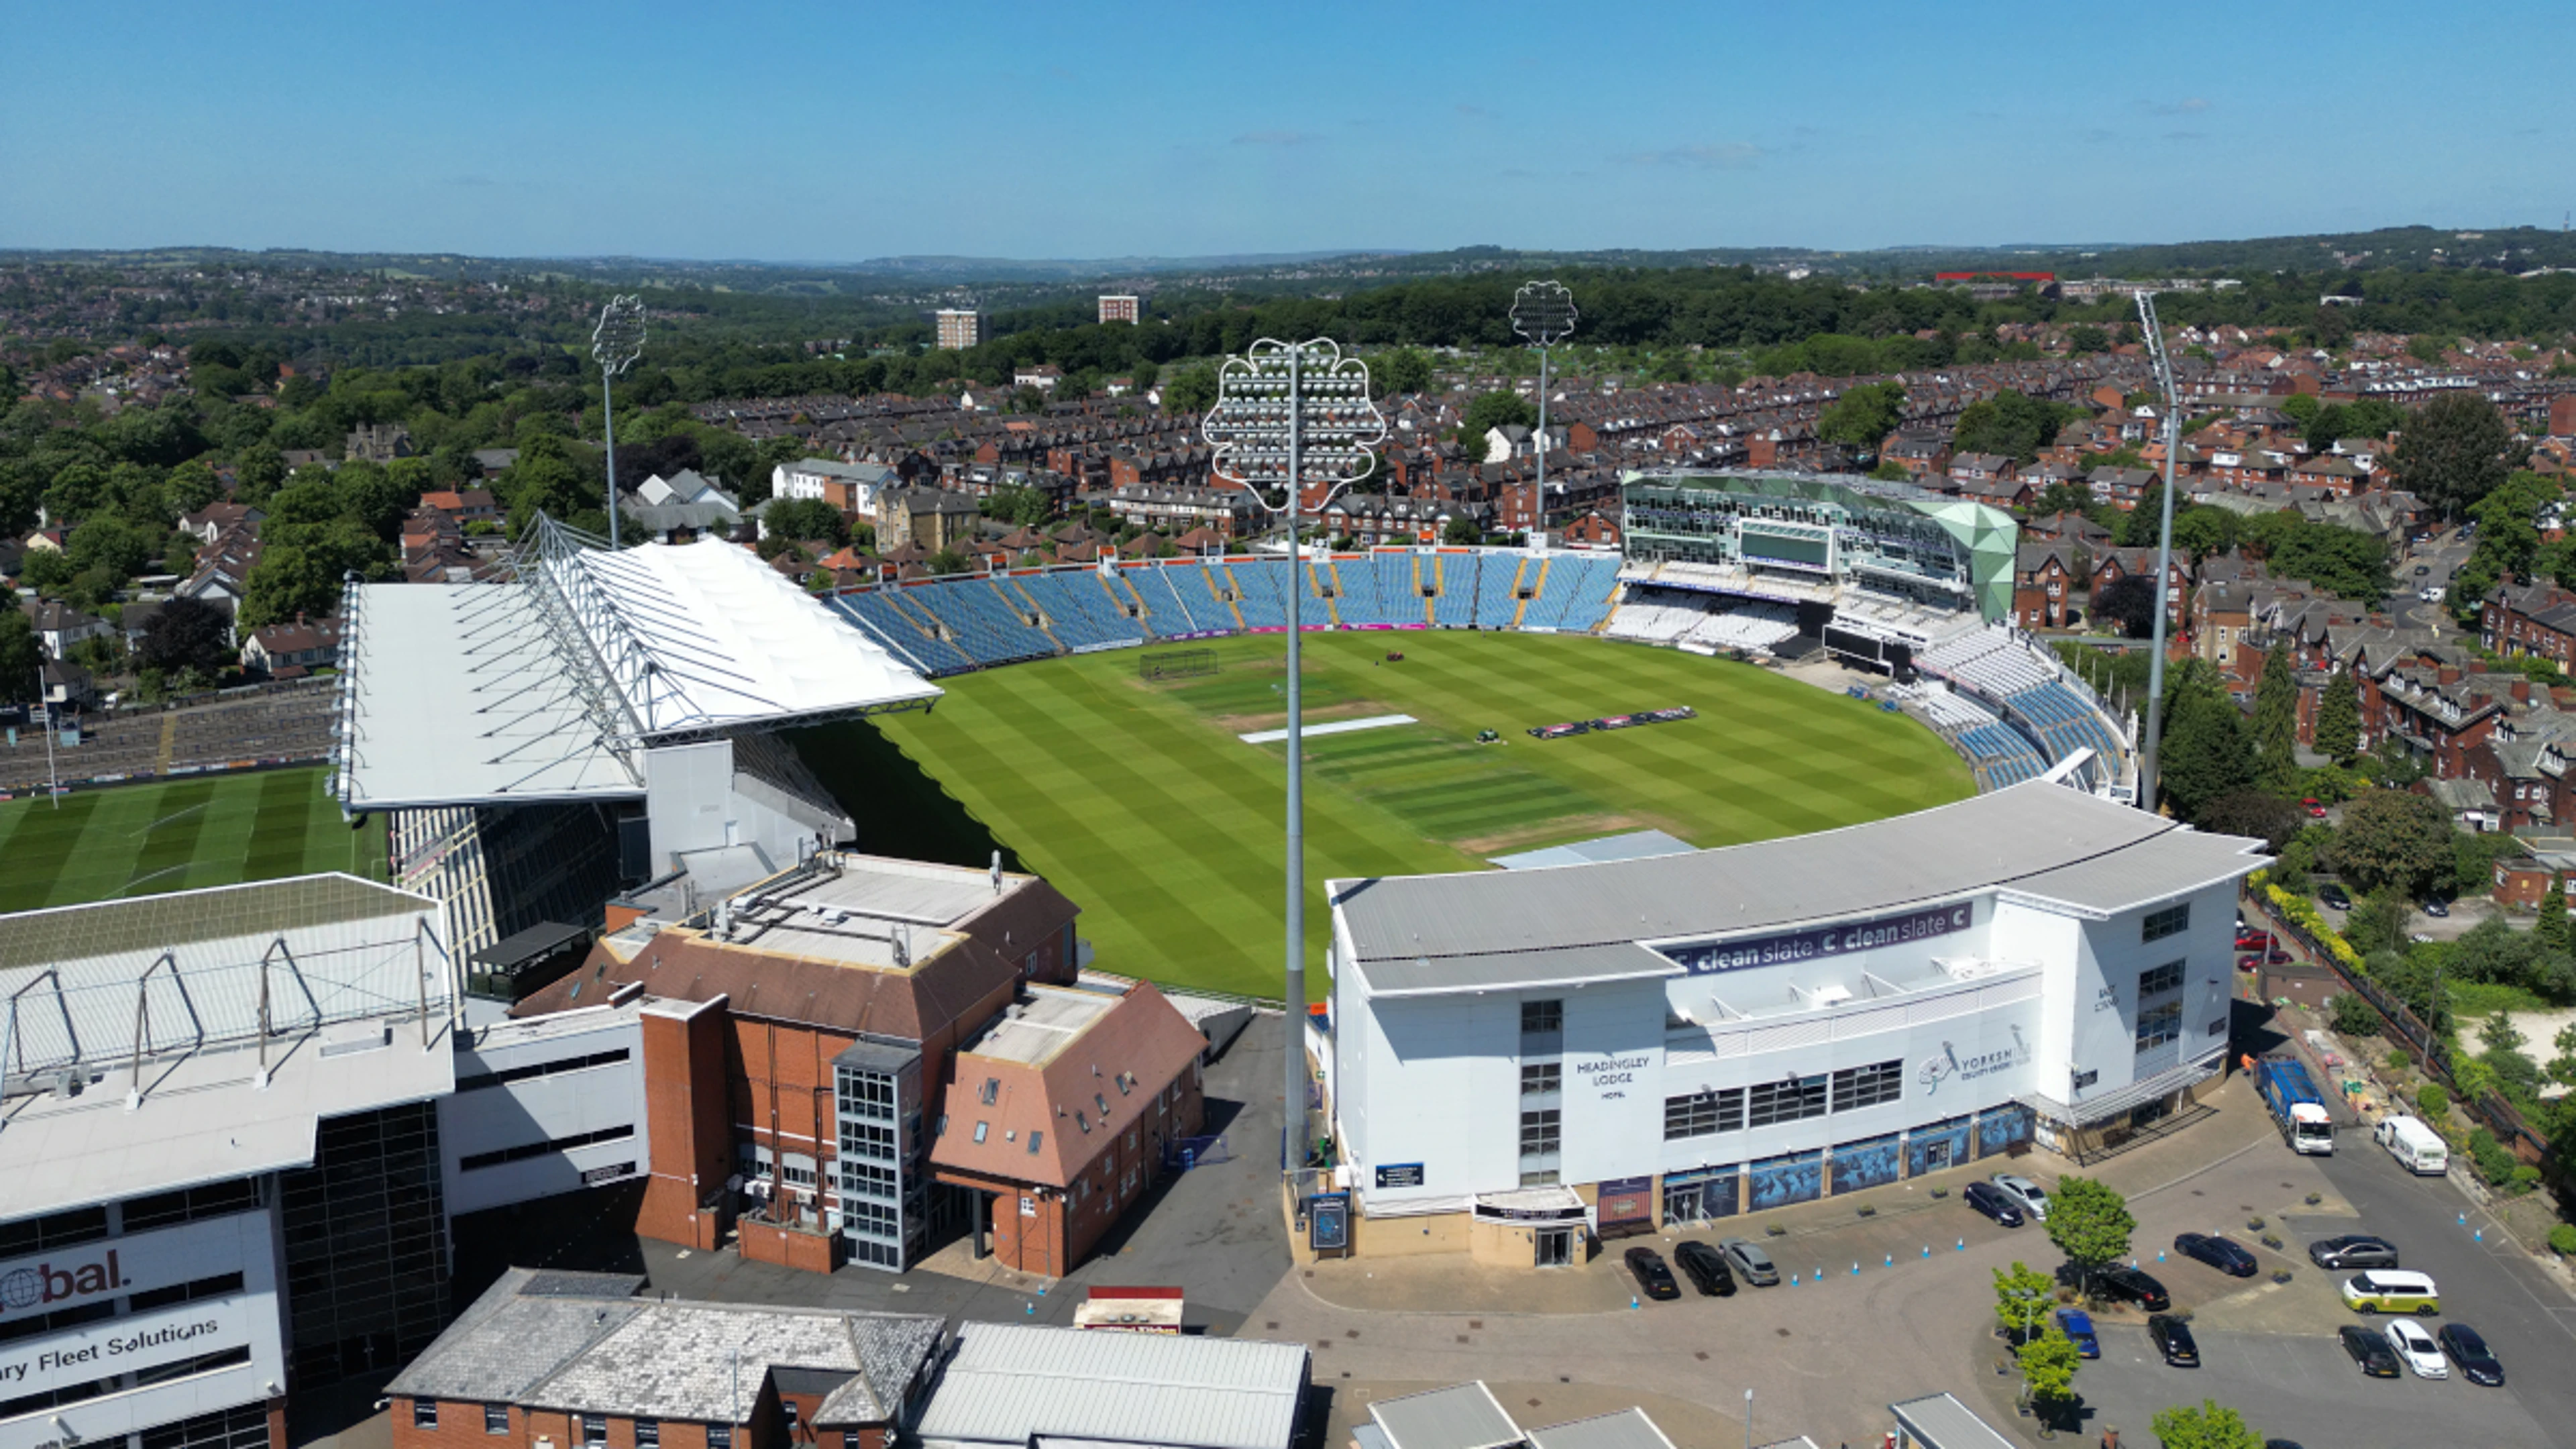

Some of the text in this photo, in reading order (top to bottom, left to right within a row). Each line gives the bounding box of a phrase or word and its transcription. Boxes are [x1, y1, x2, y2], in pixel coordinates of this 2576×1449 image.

[1698, 949, 1759, 971] clean
[1763, 940, 1813, 962] slate
[1845, 925, 1898, 949] clean
[1902, 916, 1945, 938] slate
[1578, 1057, 1650, 1074] HEADINGLEY
[1593, 1073, 1633, 1087] LODGE
[39, 1344, 99, 1372] Fleet
[108, 1320, 219, 1356] Solutions
